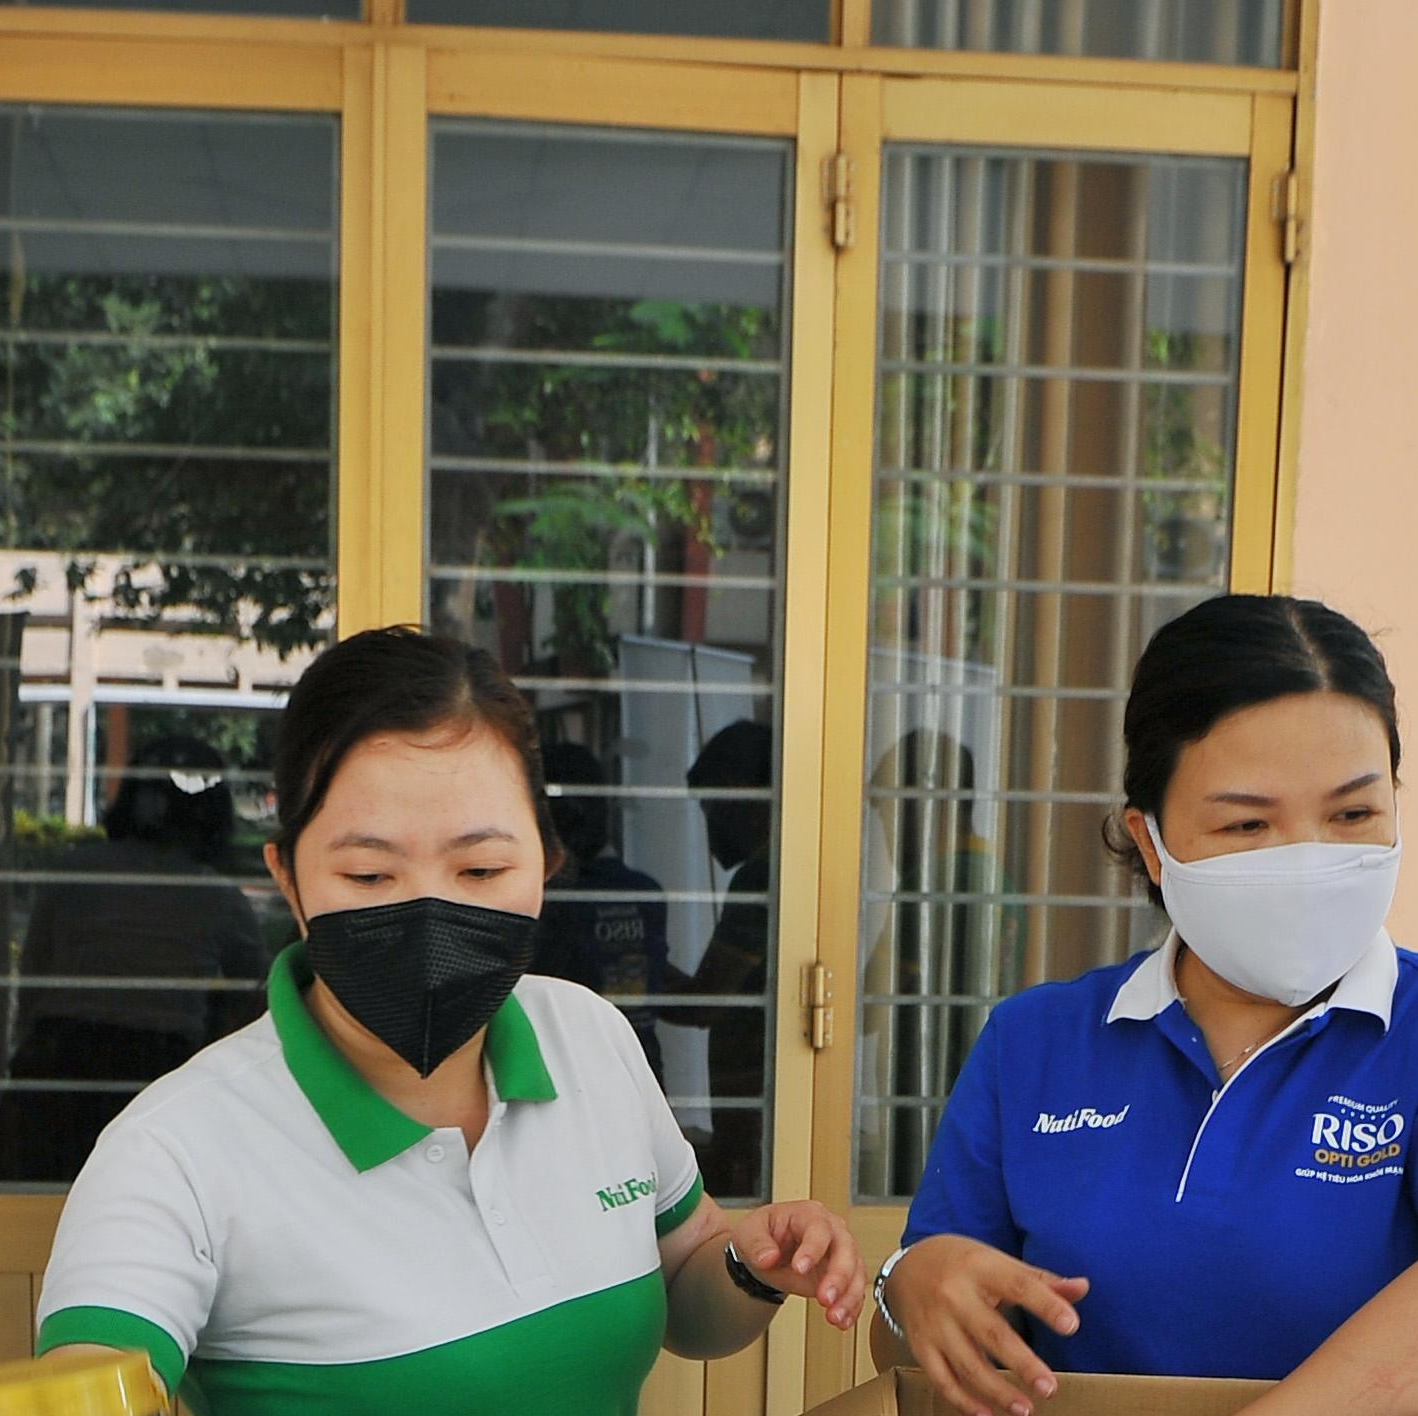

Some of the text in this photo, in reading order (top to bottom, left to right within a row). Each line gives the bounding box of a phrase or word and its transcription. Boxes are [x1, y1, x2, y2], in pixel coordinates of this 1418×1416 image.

[1033, 1104, 1130, 1134] NutiFood
[1312, 1113, 1404, 1152] RISO
[1314, 1143, 1401, 1167] OPTI GOLD
